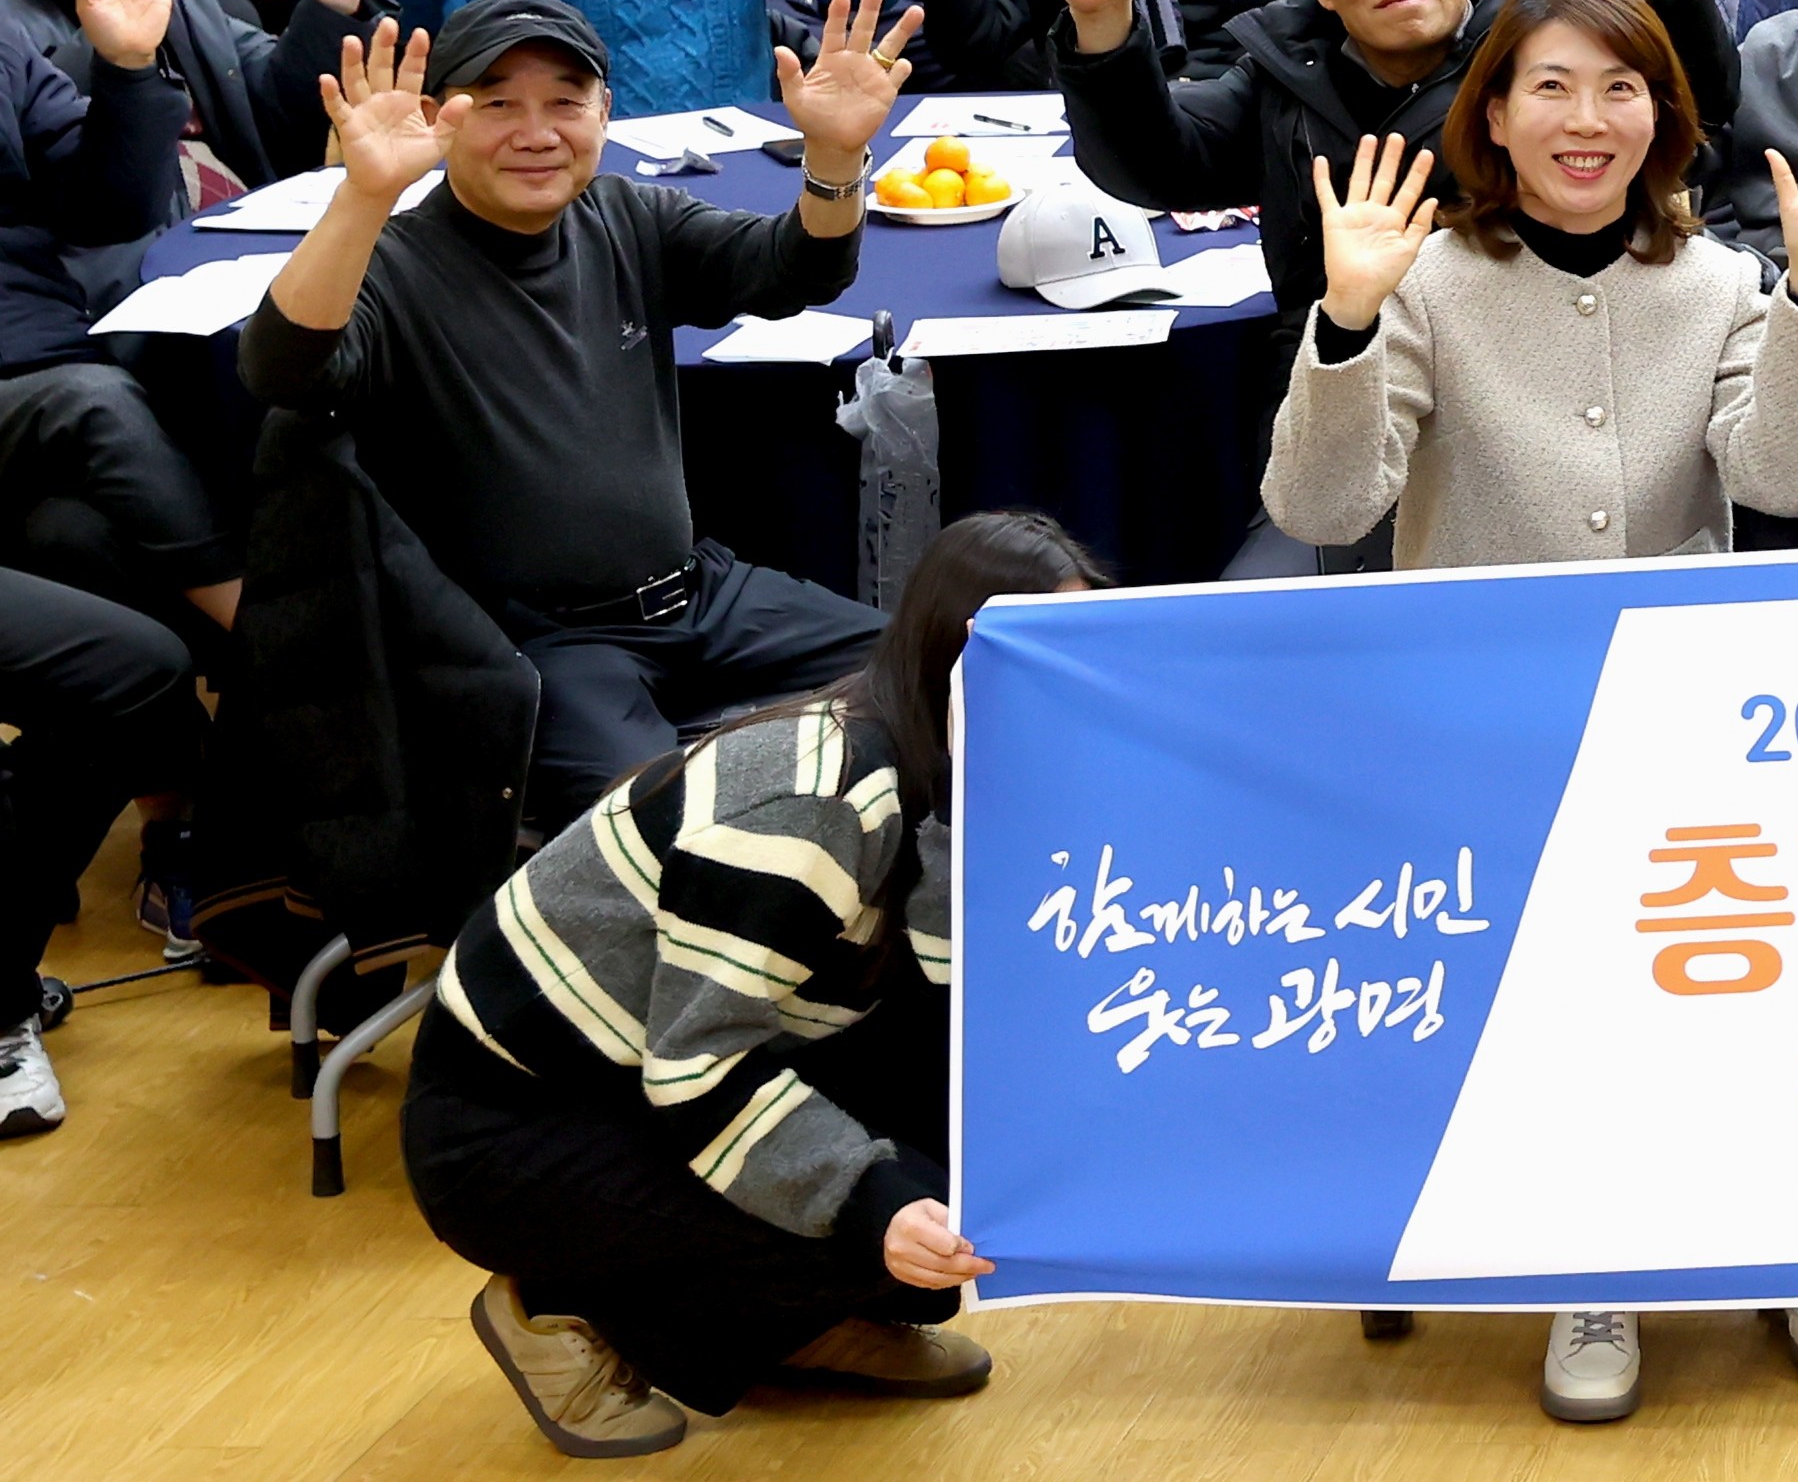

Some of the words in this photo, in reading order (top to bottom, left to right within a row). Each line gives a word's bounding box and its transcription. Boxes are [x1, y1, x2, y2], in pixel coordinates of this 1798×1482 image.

[1088, 216, 1126, 260] A
[1028, 845, 1325, 958] 함께하는
[1335, 847, 1489, 939] 시민
[1088, 968, 1240, 1073] 웃는
[1252, 959, 1456, 1053] 광명
